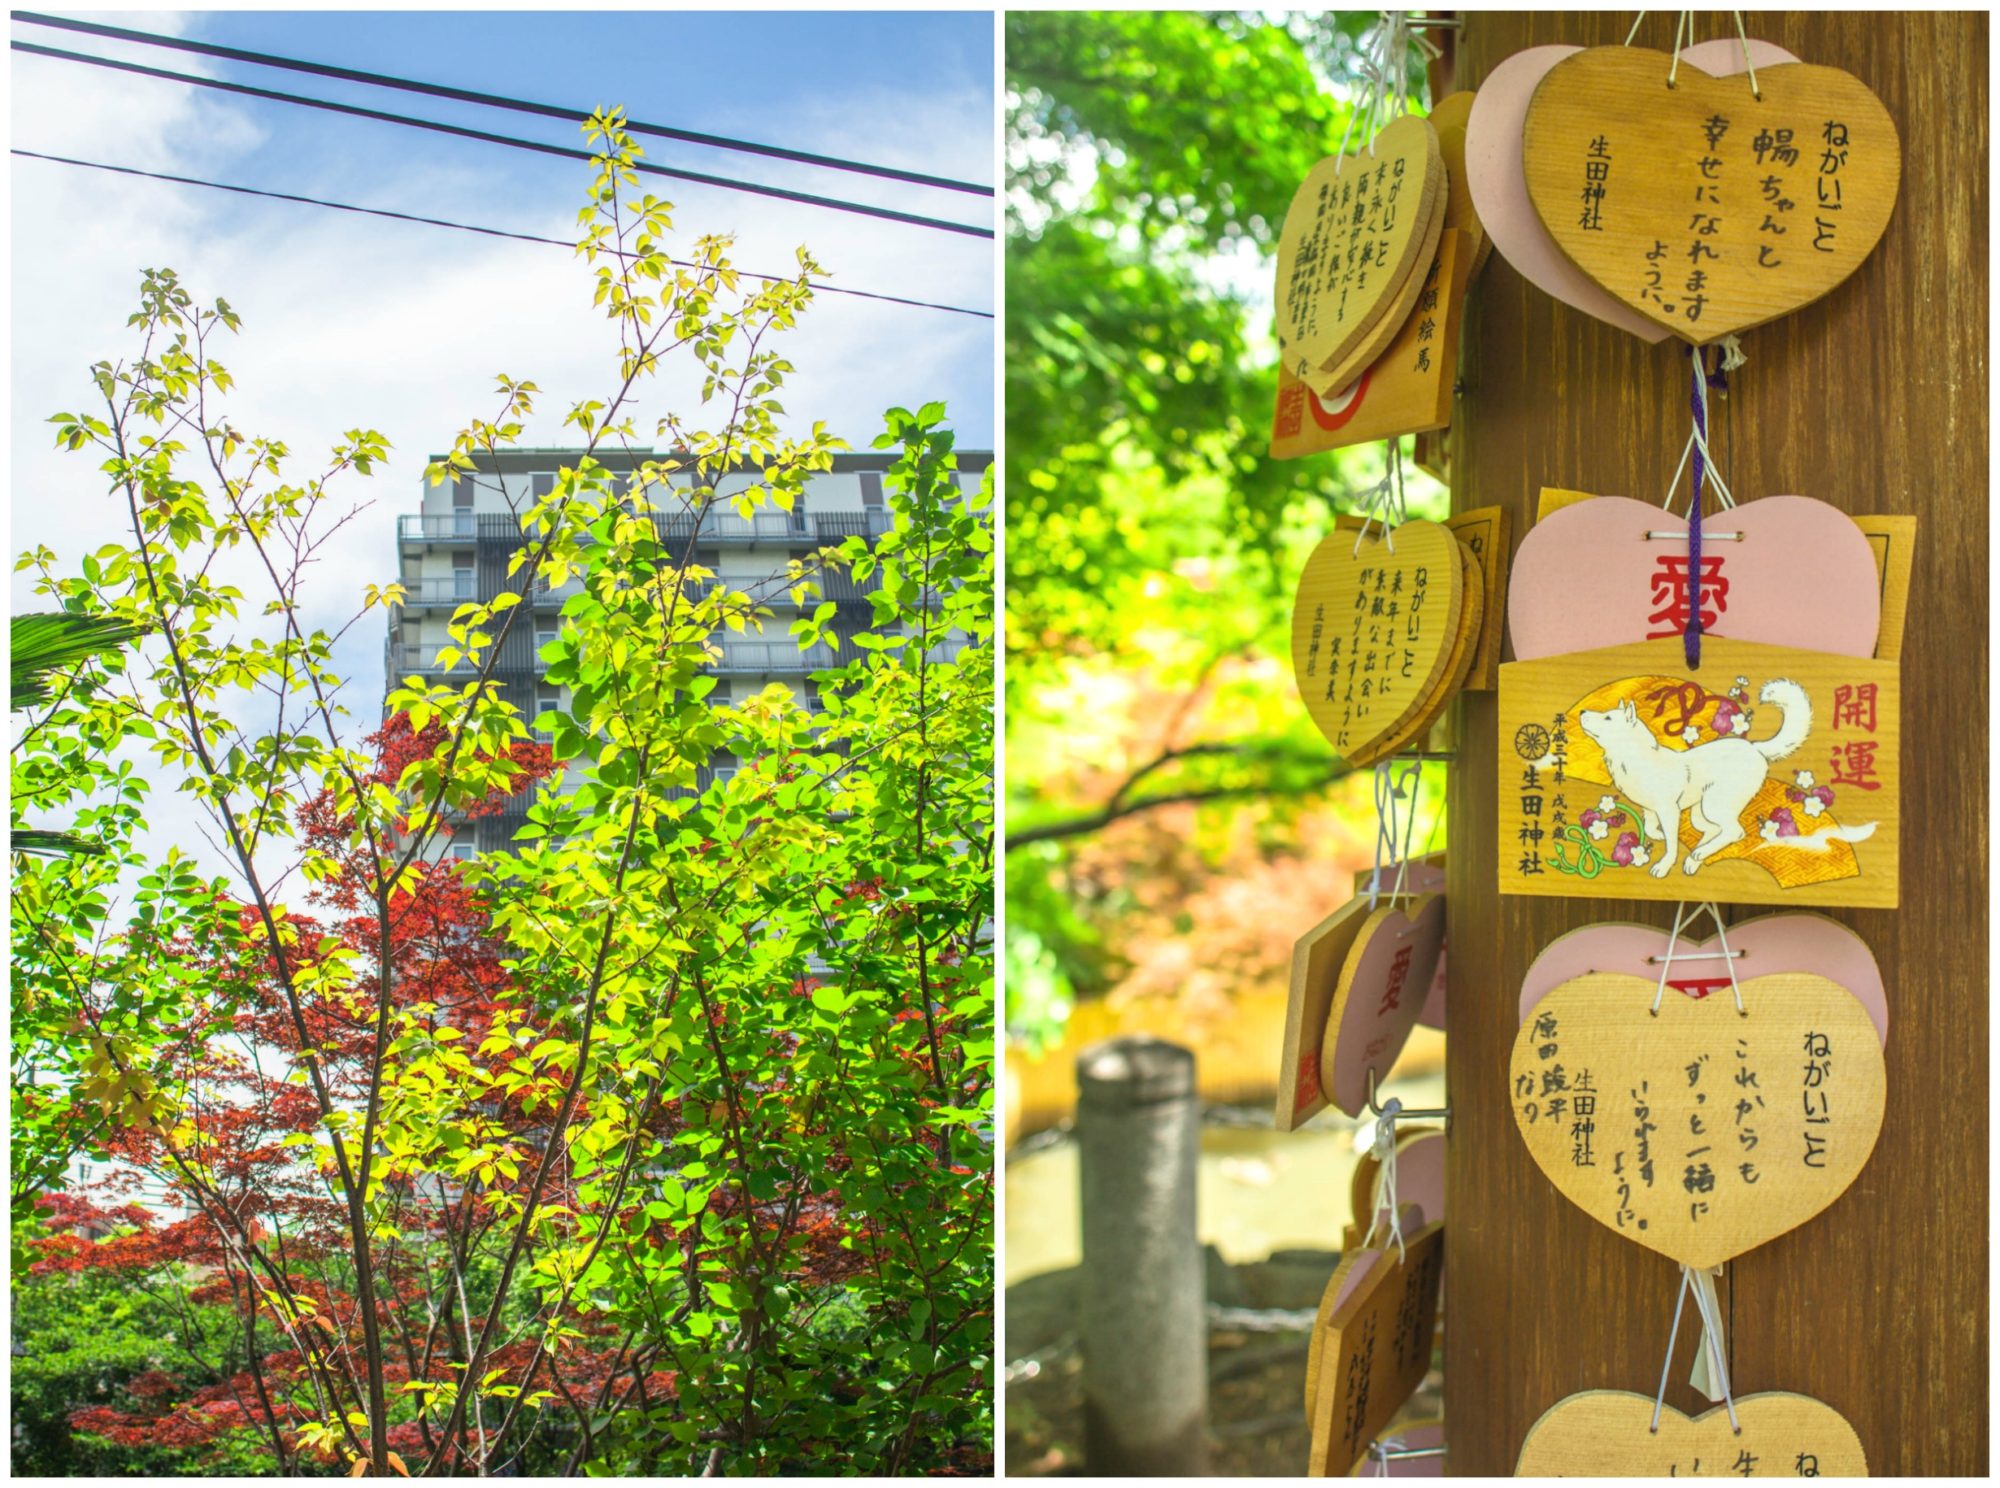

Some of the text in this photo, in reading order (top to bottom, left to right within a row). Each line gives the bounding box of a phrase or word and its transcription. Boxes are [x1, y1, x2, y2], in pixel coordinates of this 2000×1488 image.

[1375, 157, 1405, 268] ねがいごと
[1577, 135, 1612, 231] 生田神社
[1683, 114, 1729, 322] 幸せになれます
[1812, 119, 1849, 253] ねがいごと
[1641, 239, 1676, 314] ように。
[1356, 568, 1387, 718] 素敵な出会い
[1379, 569, 1403, 695] 来年までに
[1401, 566, 1428, 678] ねがいごと
[1645, 554, 1730, 640] 愛
[1337, 567, 1374, 747] がありますように
[1551, 712, 1568, 786] 平成三十年
[1829, 682, 1882, 792] 開運
[1518, 764, 1545, 878] 生田神社
[1570, 1067, 1598, 1167] 生田神社
[1682, 1053, 1716, 1222] ずっと一緒に
[1734, 1039, 1765, 1184] これからも
[1803, 1031, 1832, 1168] ねがいごと
